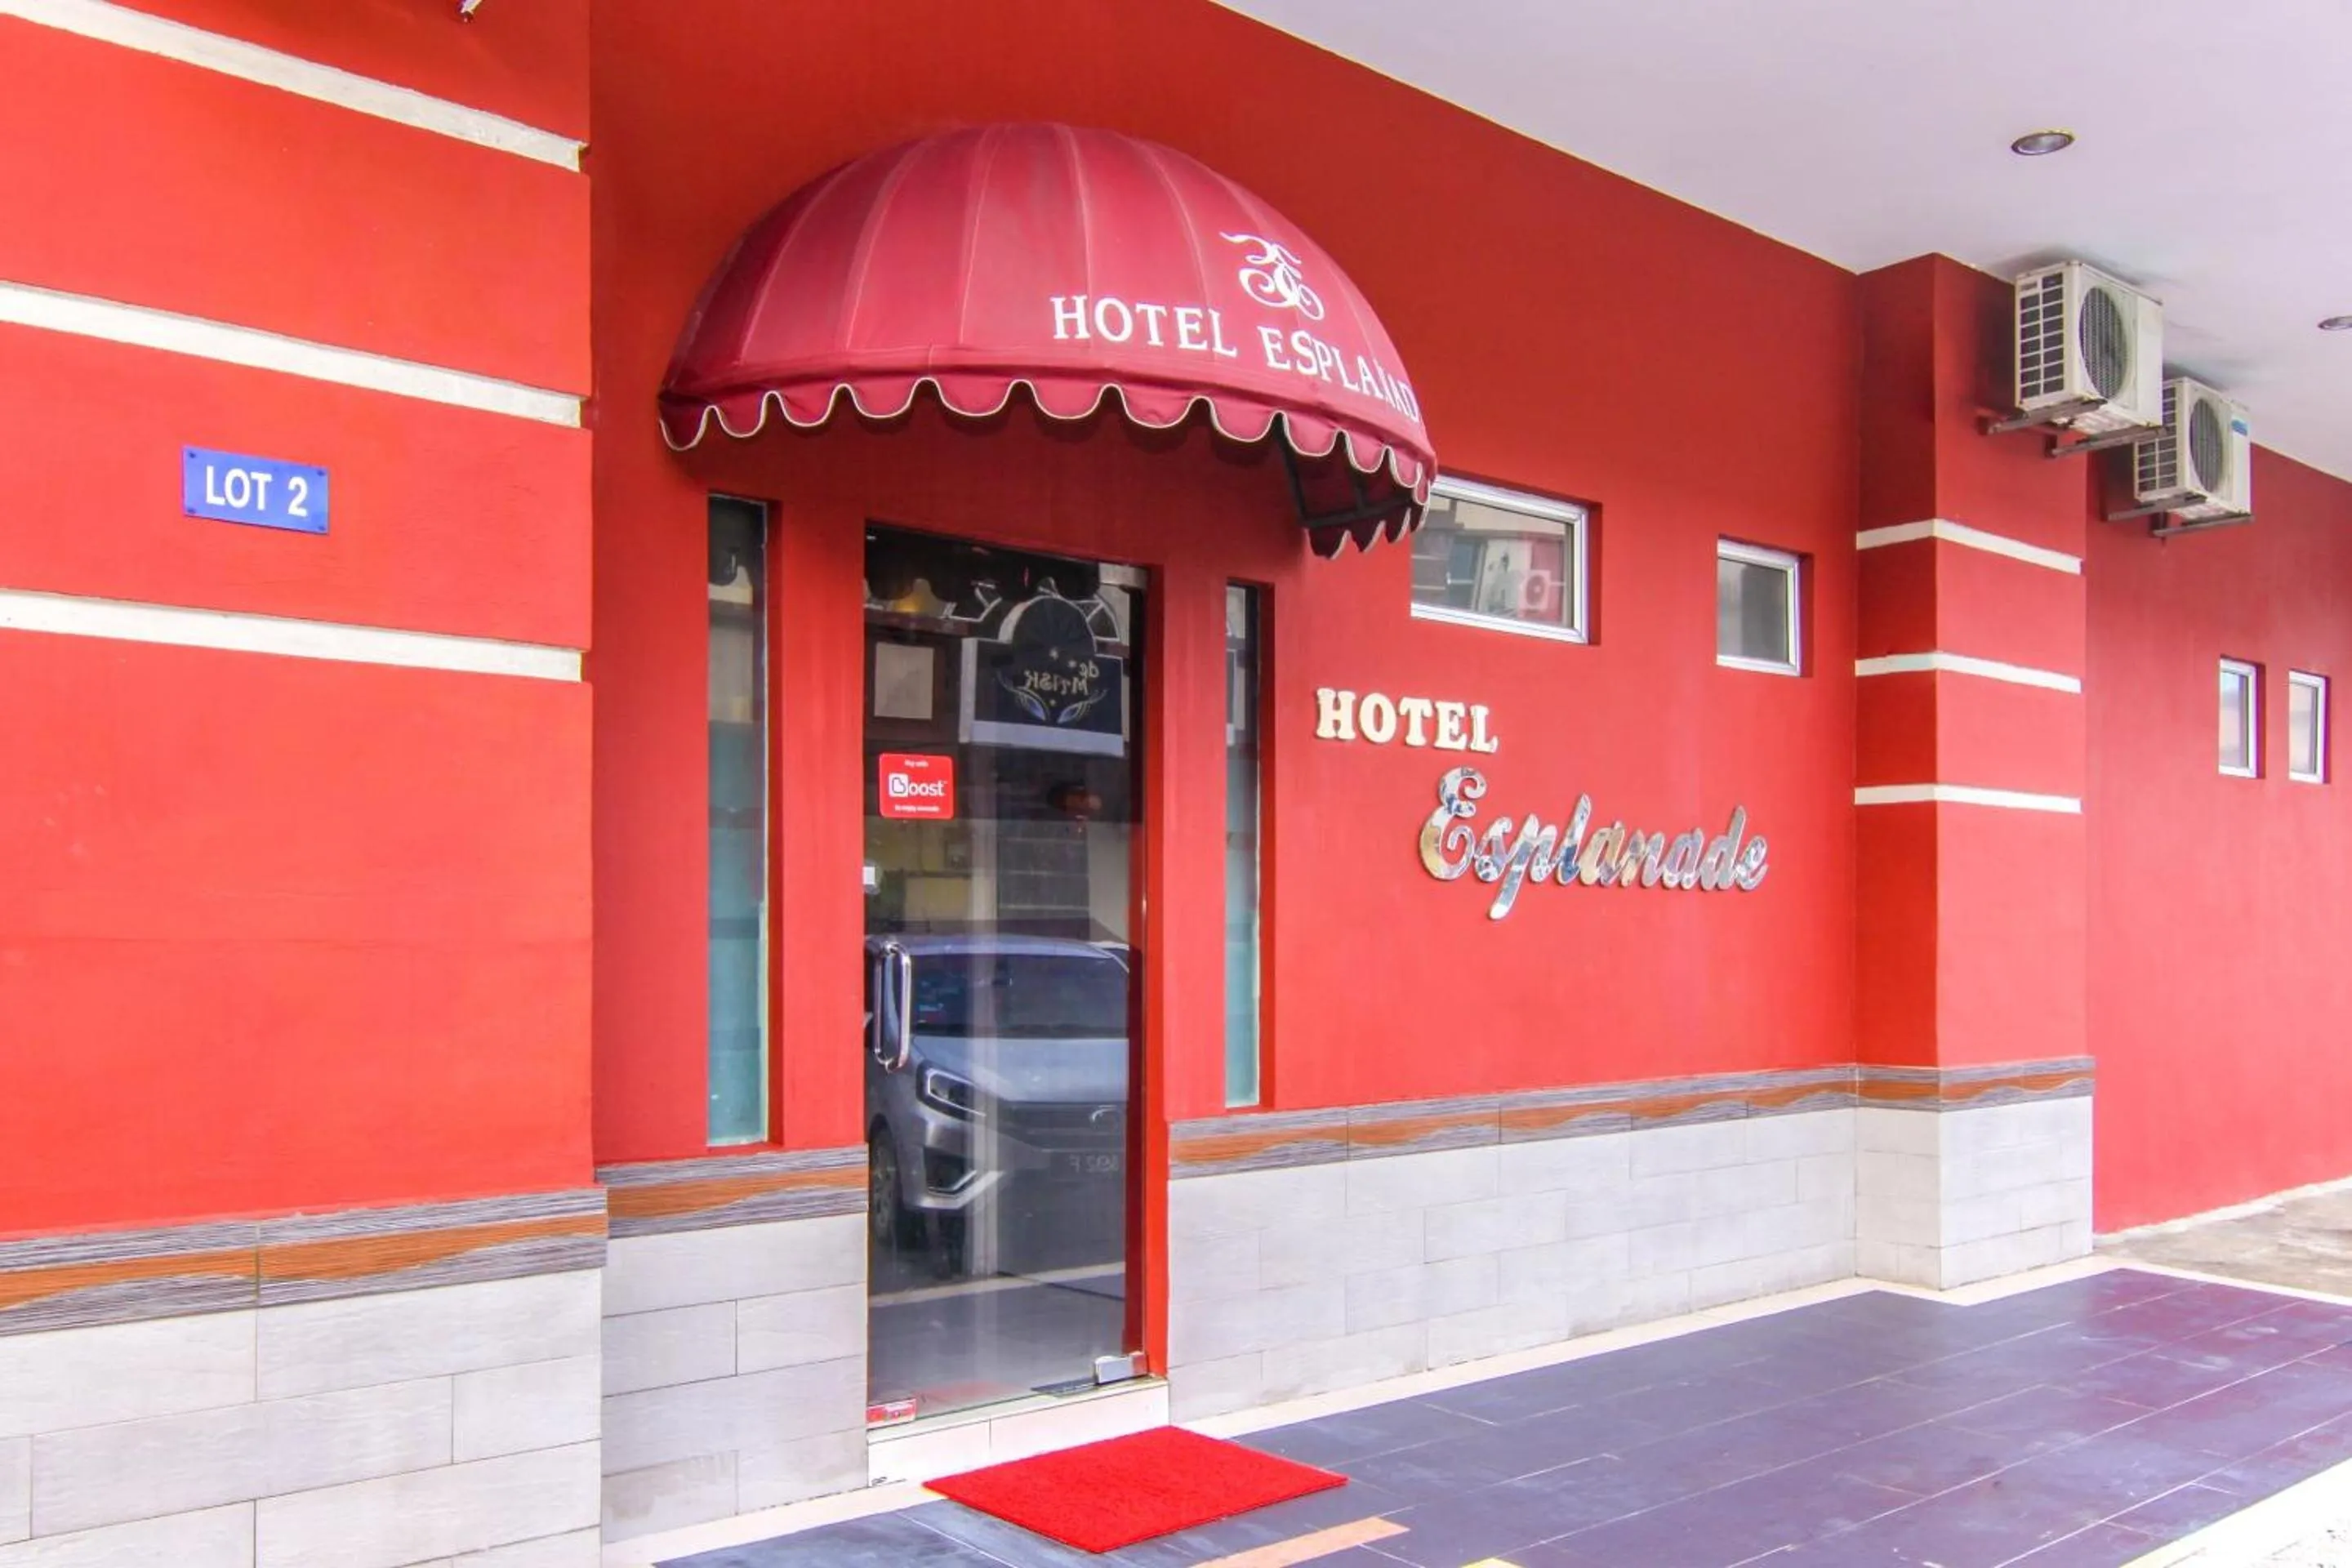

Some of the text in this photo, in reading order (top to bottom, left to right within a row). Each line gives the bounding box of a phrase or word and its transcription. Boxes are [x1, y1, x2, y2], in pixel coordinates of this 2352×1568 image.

[1050, 295, 1238, 357] HOTEL
[206, 465, 309, 518] LOT 2
[1316, 688, 1498, 753] HOTEL
[889, 773, 945, 797] Boost
[1419, 766, 1768, 920] Esplanade
